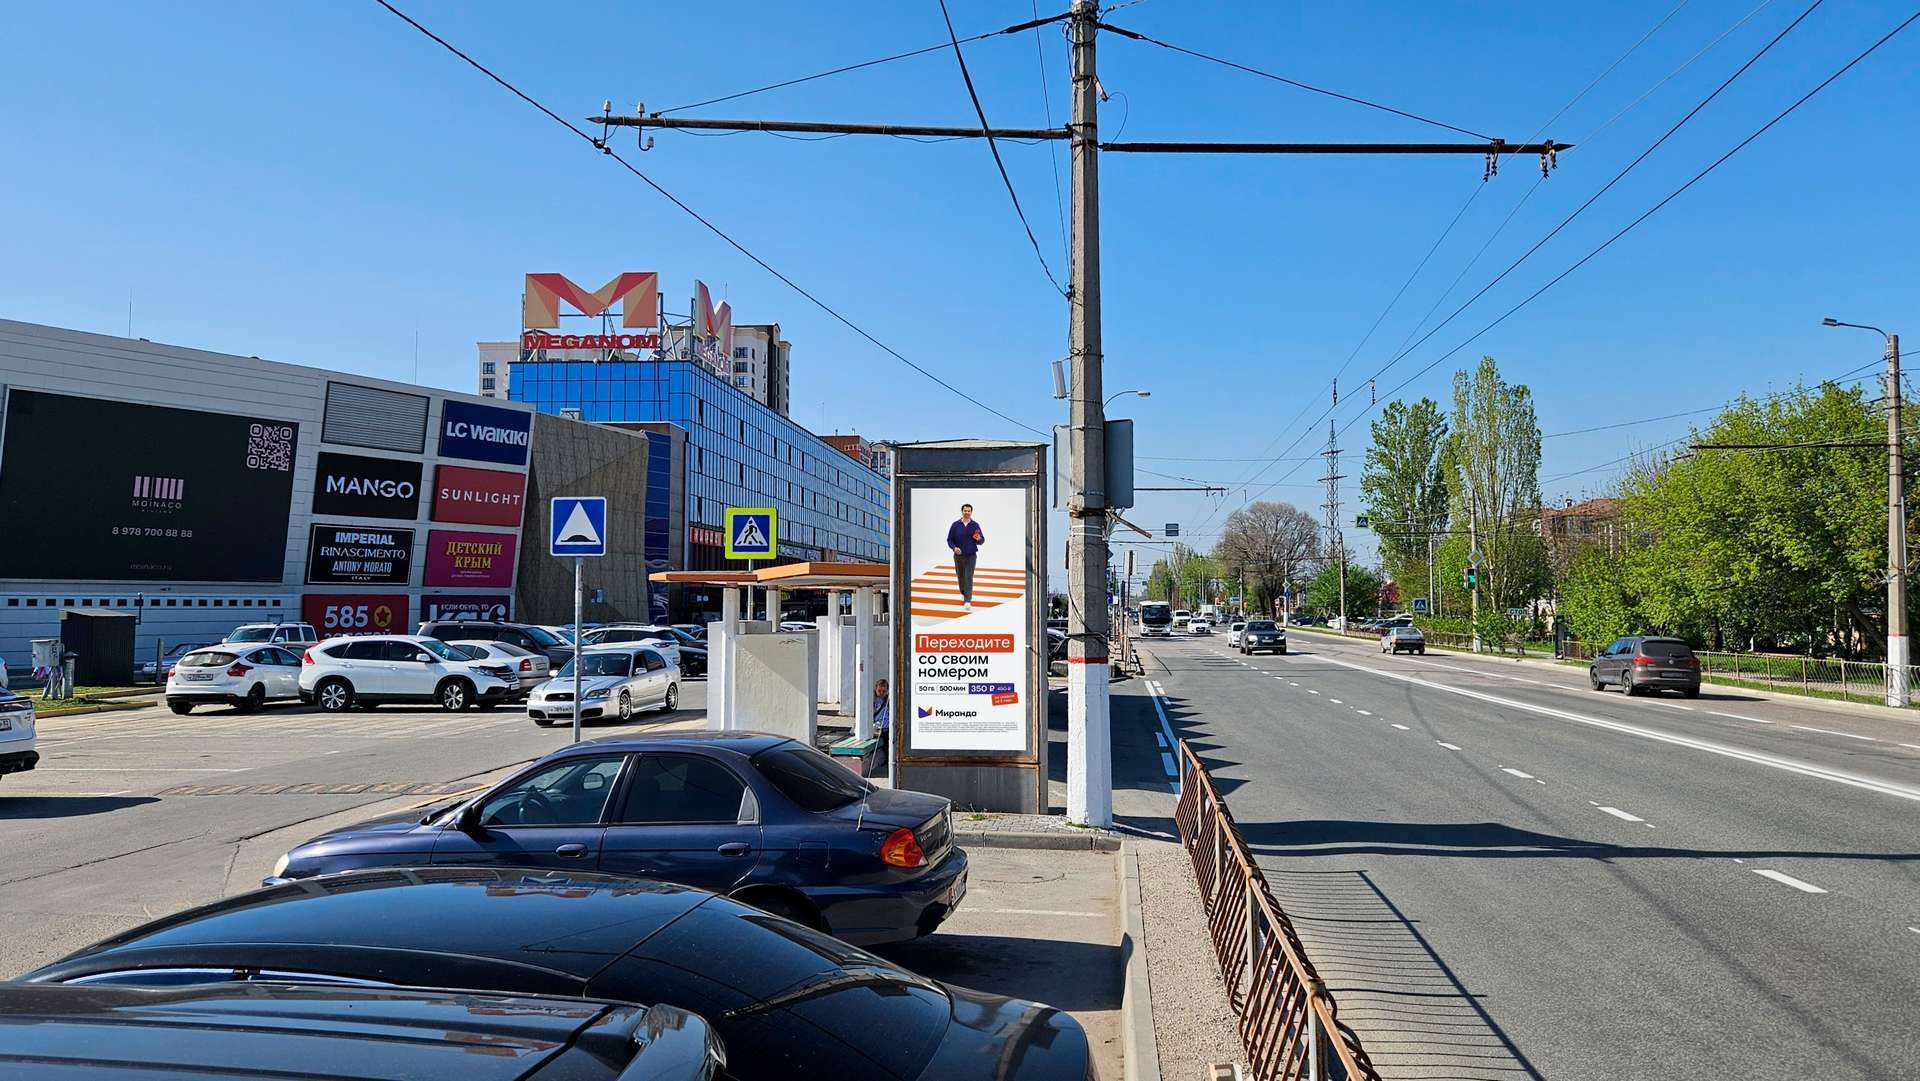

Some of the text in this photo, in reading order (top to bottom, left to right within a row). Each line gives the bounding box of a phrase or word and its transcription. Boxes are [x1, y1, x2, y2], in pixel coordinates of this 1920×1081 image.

[524, 335, 660, 349] MEGANOM
[446, 421, 468, 438] LC
[326, 475, 414, 499] MANGO
[441, 488, 520, 505] SUNLIGHT
[112, 527, 193, 538] 8 978 700 88 88
[335, 532, 395, 545] IMPERIAL
[320, 546, 406, 559] RINASCIMENTO
[446, 541, 503, 556] ДЕТСКИЙ
[332, 560, 392, 573] ANTONY MORATO
[455, 556, 492, 569] КРЫМ
[324, 605, 369, 628] 585
[919, 635, 1010, 651] Переходите
[918, 655, 989, 665] со своим
[918, 667, 988, 680] номером
[970, 684, 987, 692] 350
[935, 709, 977, 718] Миранда
